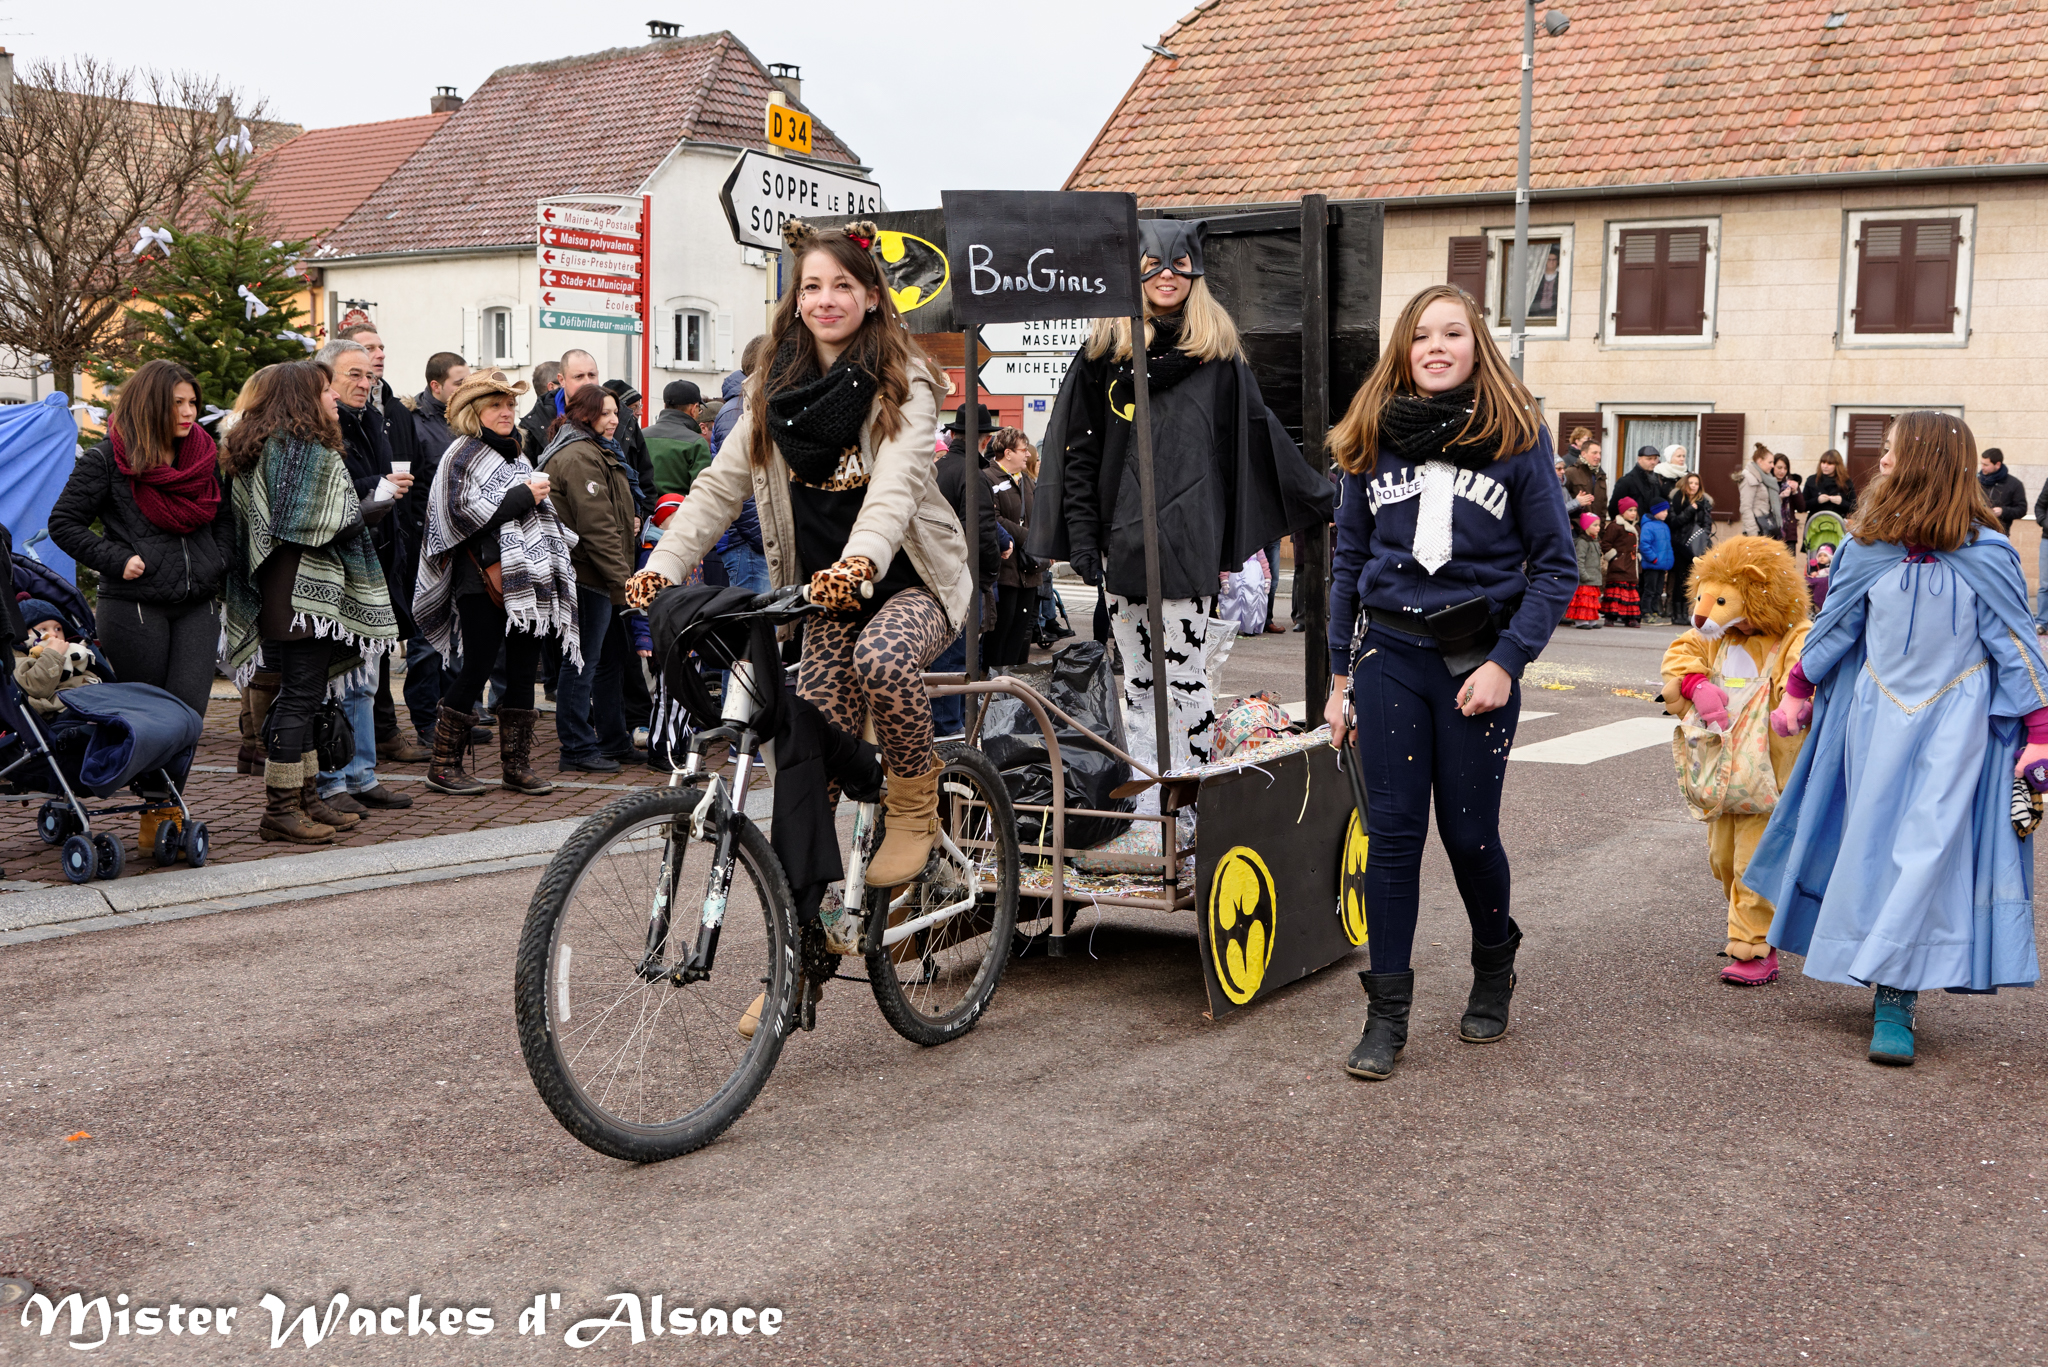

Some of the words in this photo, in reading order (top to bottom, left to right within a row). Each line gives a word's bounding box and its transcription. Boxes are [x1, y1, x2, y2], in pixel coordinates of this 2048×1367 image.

[774, 112, 782, 138] D
[788, 117, 807, 145] 34
[762, 170, 818, 207] SOPPE
[827, 194, 839, 212] LE
[847, 191, 875, 215] BAS
[564, 212, 604, 230] Mairie-Ag
[606, 218, 634, 231] Postale
[560, 232, 588, 245] Maison
[590, 239, 634, 253] polyvalente
[560, 252, 635, 272] Église-Presbytère
[605, 298, 634, 311] Écoles
[560, 315, 634, 332] Défibrillateur-mairie
[1022, 334, 1090, 346] MASEVAU
[1376, 480, 1421, 500] POLICE
